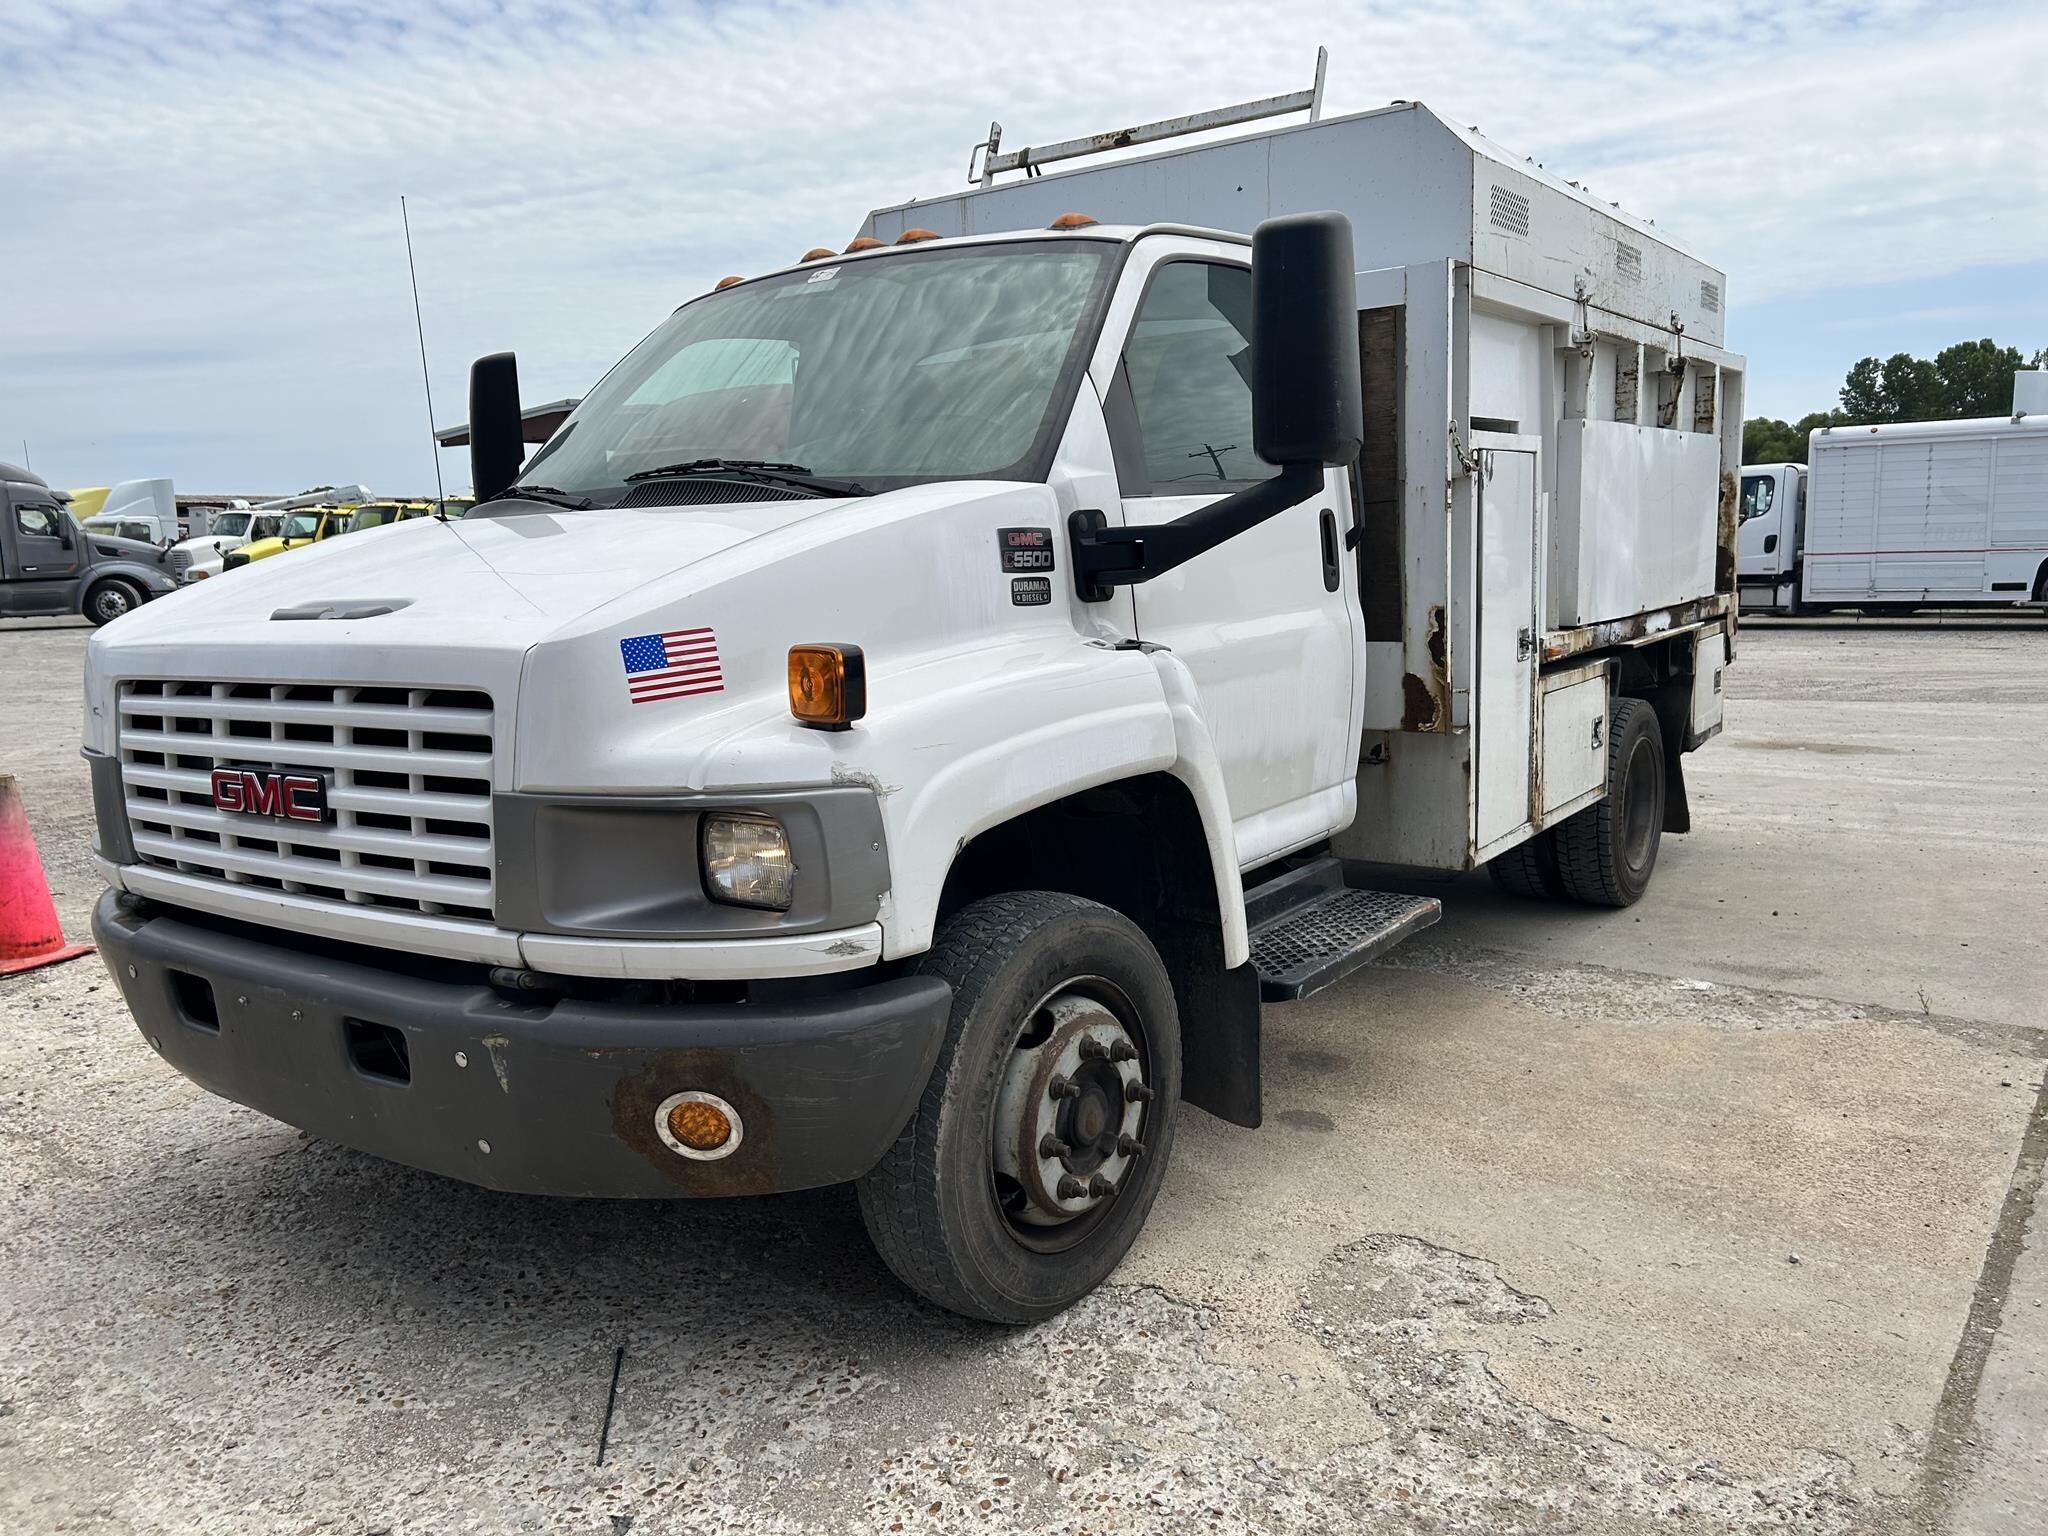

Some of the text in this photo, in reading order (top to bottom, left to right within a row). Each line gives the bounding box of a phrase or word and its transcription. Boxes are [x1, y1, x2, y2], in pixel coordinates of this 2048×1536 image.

[1008, 532, 1043, 545] GMC
[1004, 551, 1051, 567] C5500
[1013, 581, 1049, 591] DURAMAX
[1022, 593, 1042, 602] DIESEL
[211, 769, 321, 821] GMC
